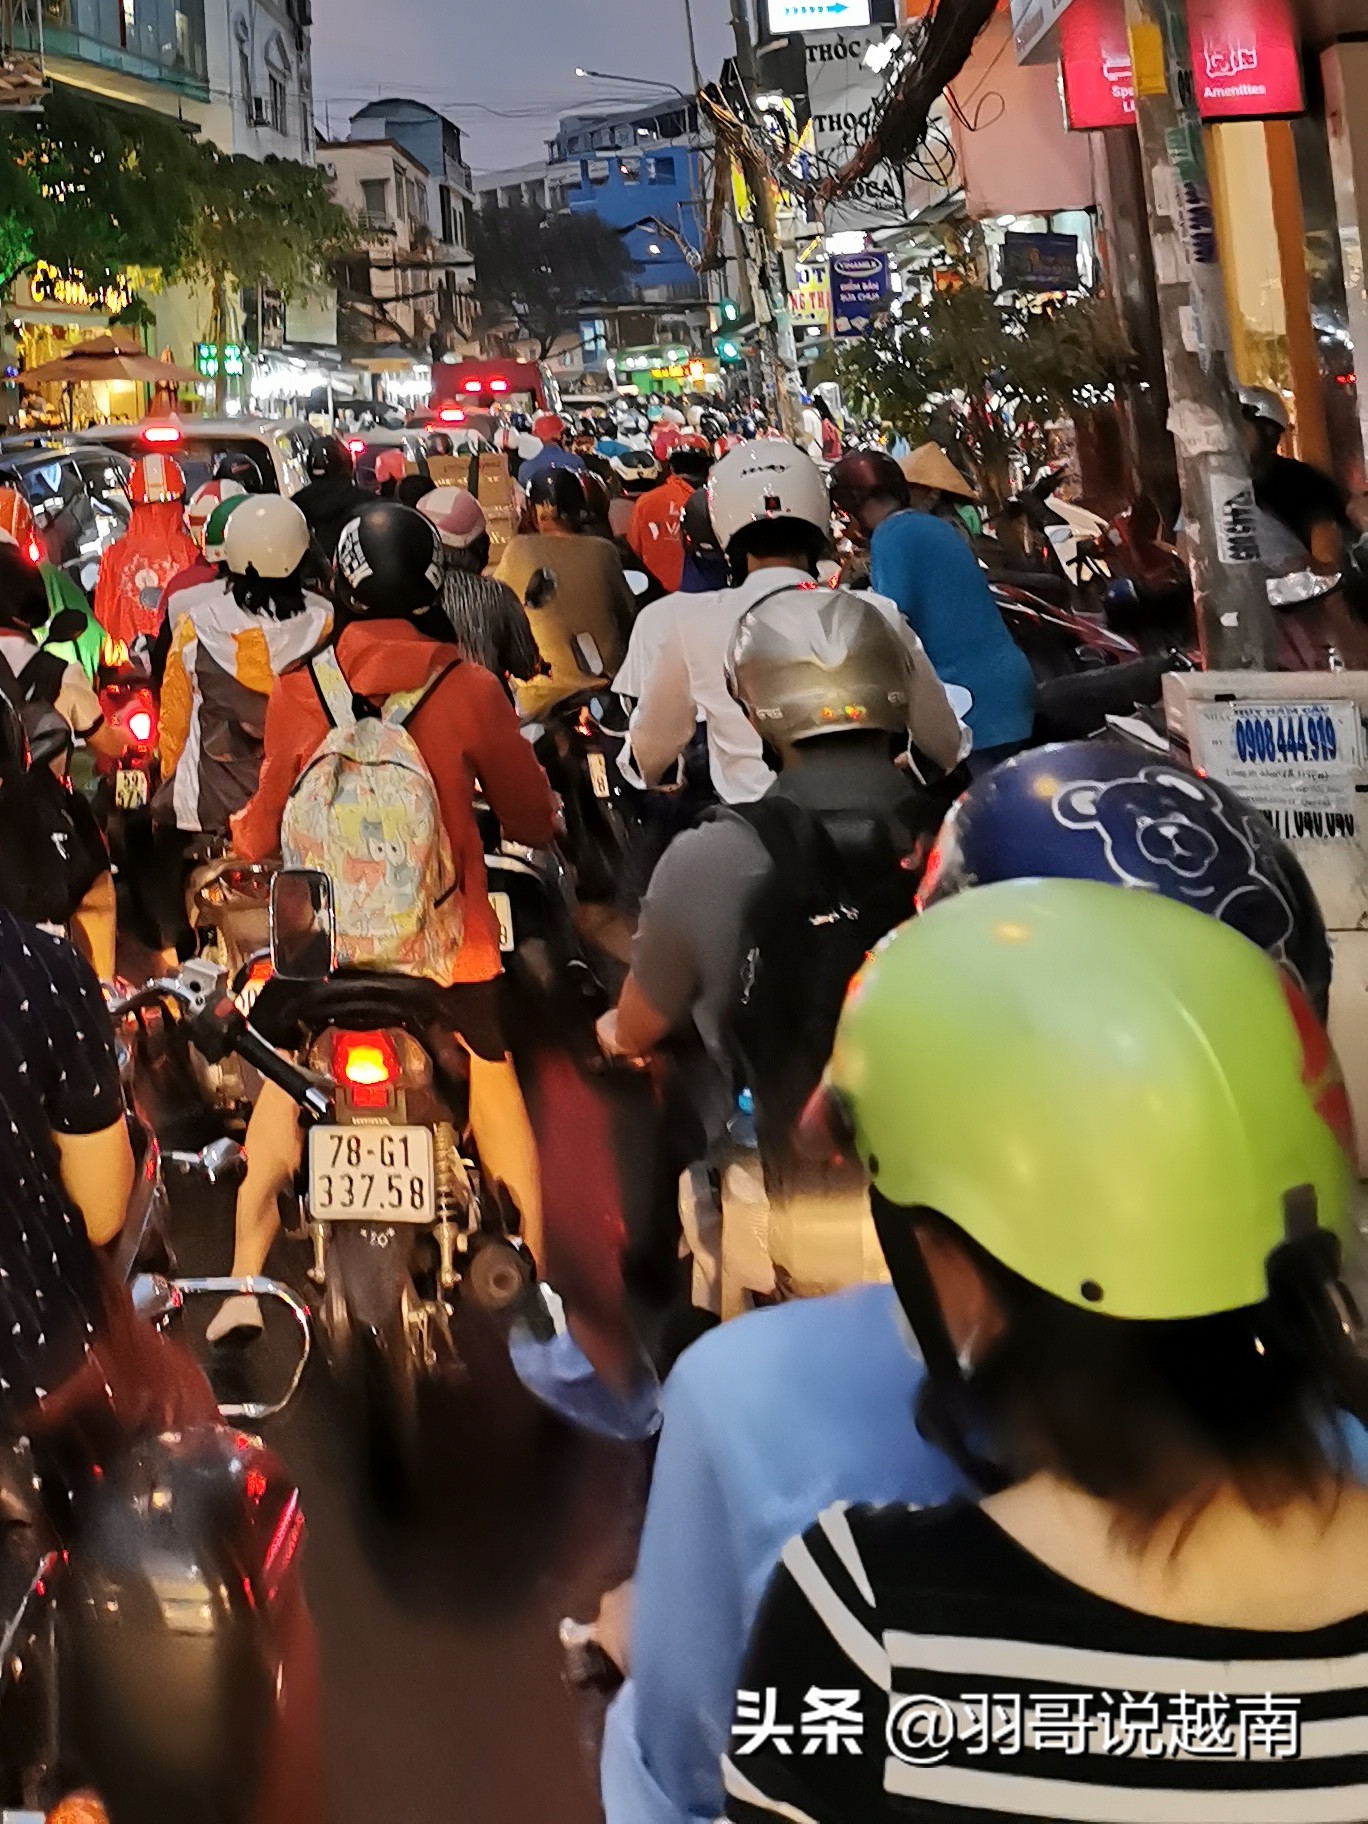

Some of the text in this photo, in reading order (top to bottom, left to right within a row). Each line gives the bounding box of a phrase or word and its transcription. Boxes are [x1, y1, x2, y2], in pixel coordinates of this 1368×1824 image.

[1203, 84, 1267, 98] Amenities
[329, 1133, 411, 1169] 78-G1
[318, 1174, 425, 1211] 337.58
